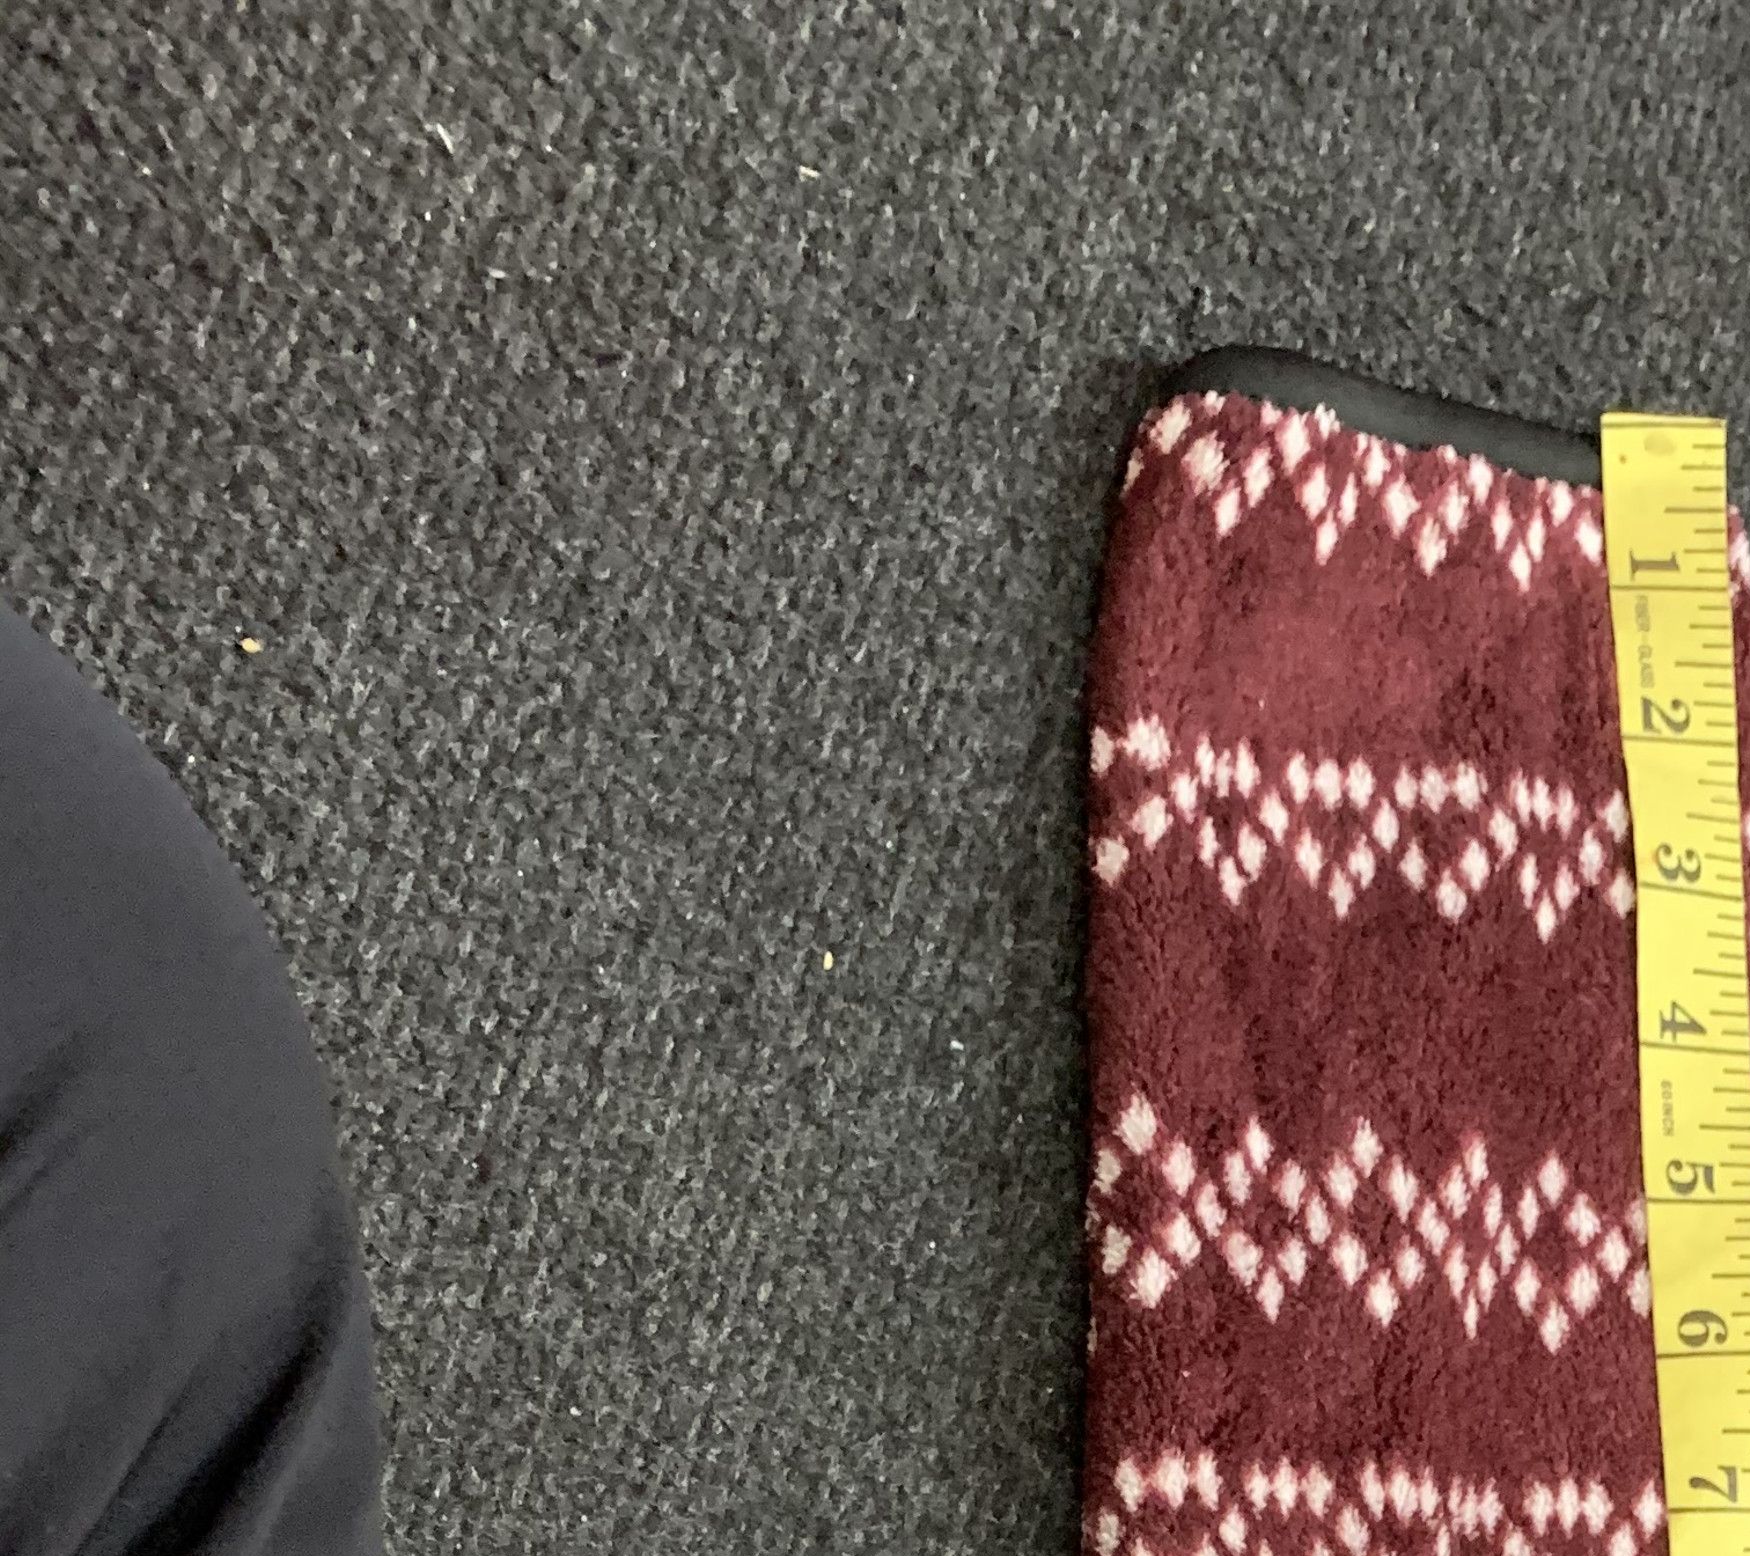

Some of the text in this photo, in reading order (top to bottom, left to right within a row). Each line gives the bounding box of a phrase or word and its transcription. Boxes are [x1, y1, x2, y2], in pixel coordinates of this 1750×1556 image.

[1629, 550, 1680, 581] 1
[1641, 696, 1691, 735] 2
[1655, 843, 1702, 884] 3
[1659, 1001, 1708, 1043] 4
[1666, 1159, 1716, 1196] 5
[1678, 1310, 1728, 1348] 6
[1689, 1465, 1738, 1503] 7
